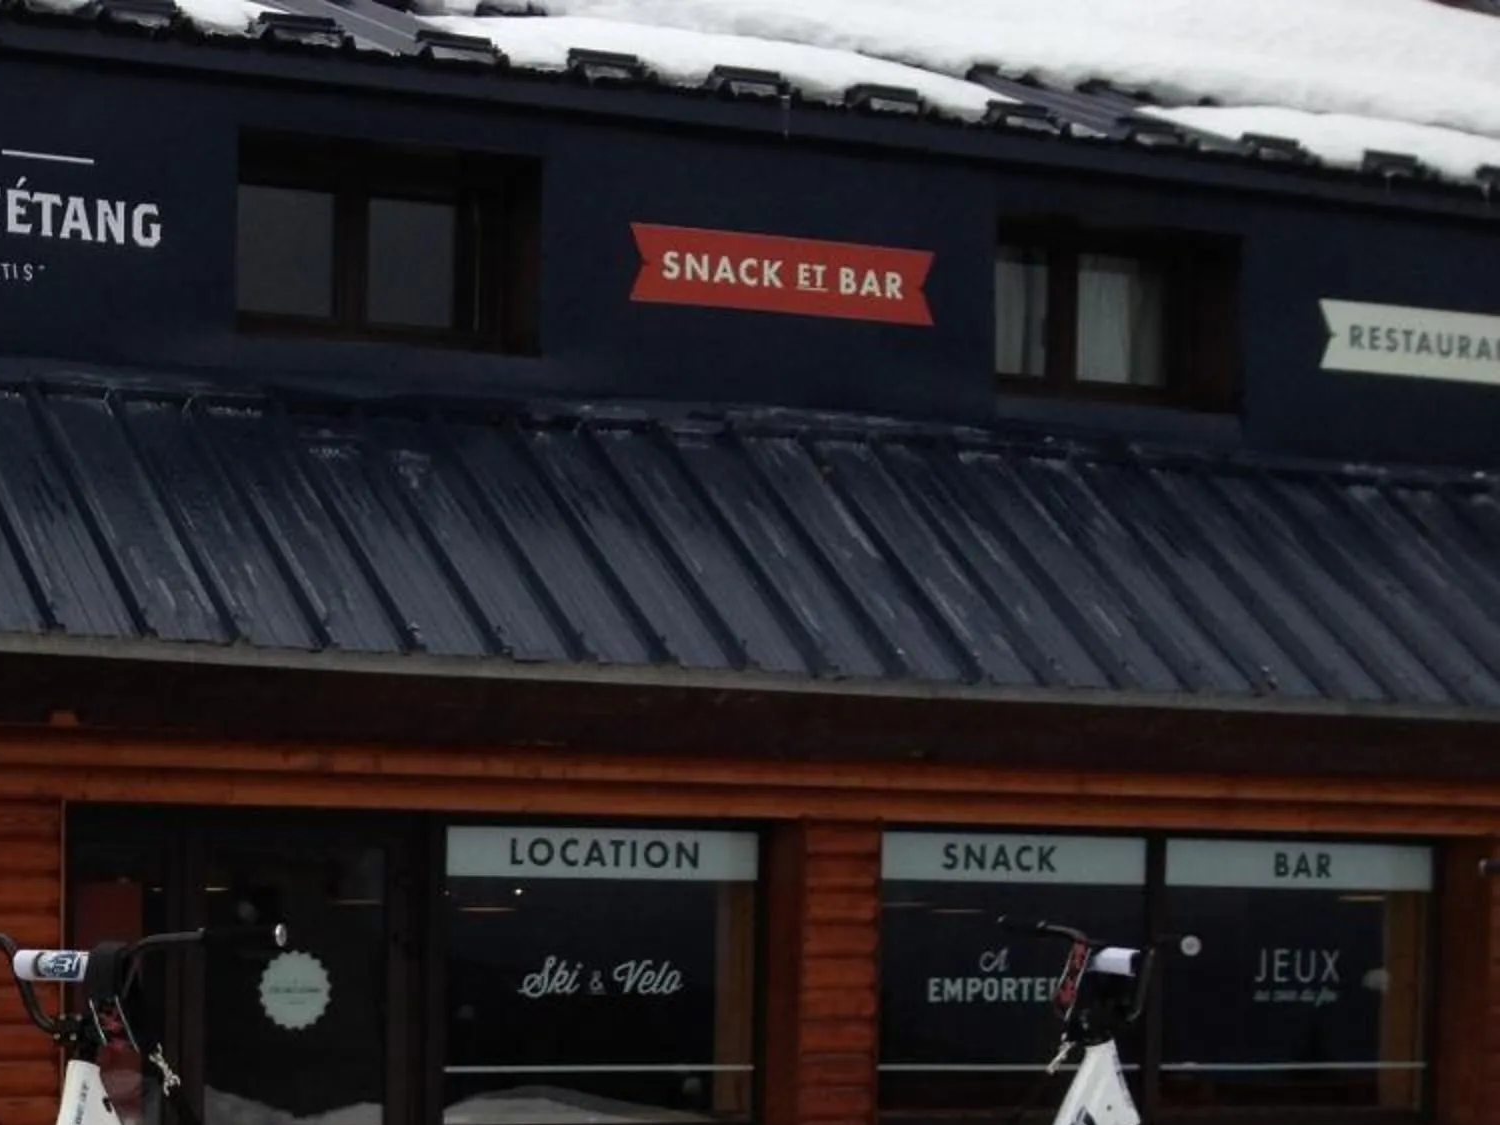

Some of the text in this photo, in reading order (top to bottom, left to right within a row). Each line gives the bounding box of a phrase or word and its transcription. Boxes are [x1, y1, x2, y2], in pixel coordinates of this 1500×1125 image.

[662, 251, 904, 300] SNACK ET BAR
[509, 837, 701, 870] LOCATION
[941, 843, 1057, 874] SNACK
[1273, 852, 1332, 879] BAR
[517, 955, 581, 999] Ski
[589, 970, 607, 997] &
[1253, 947, 1341, 984] JEUX
